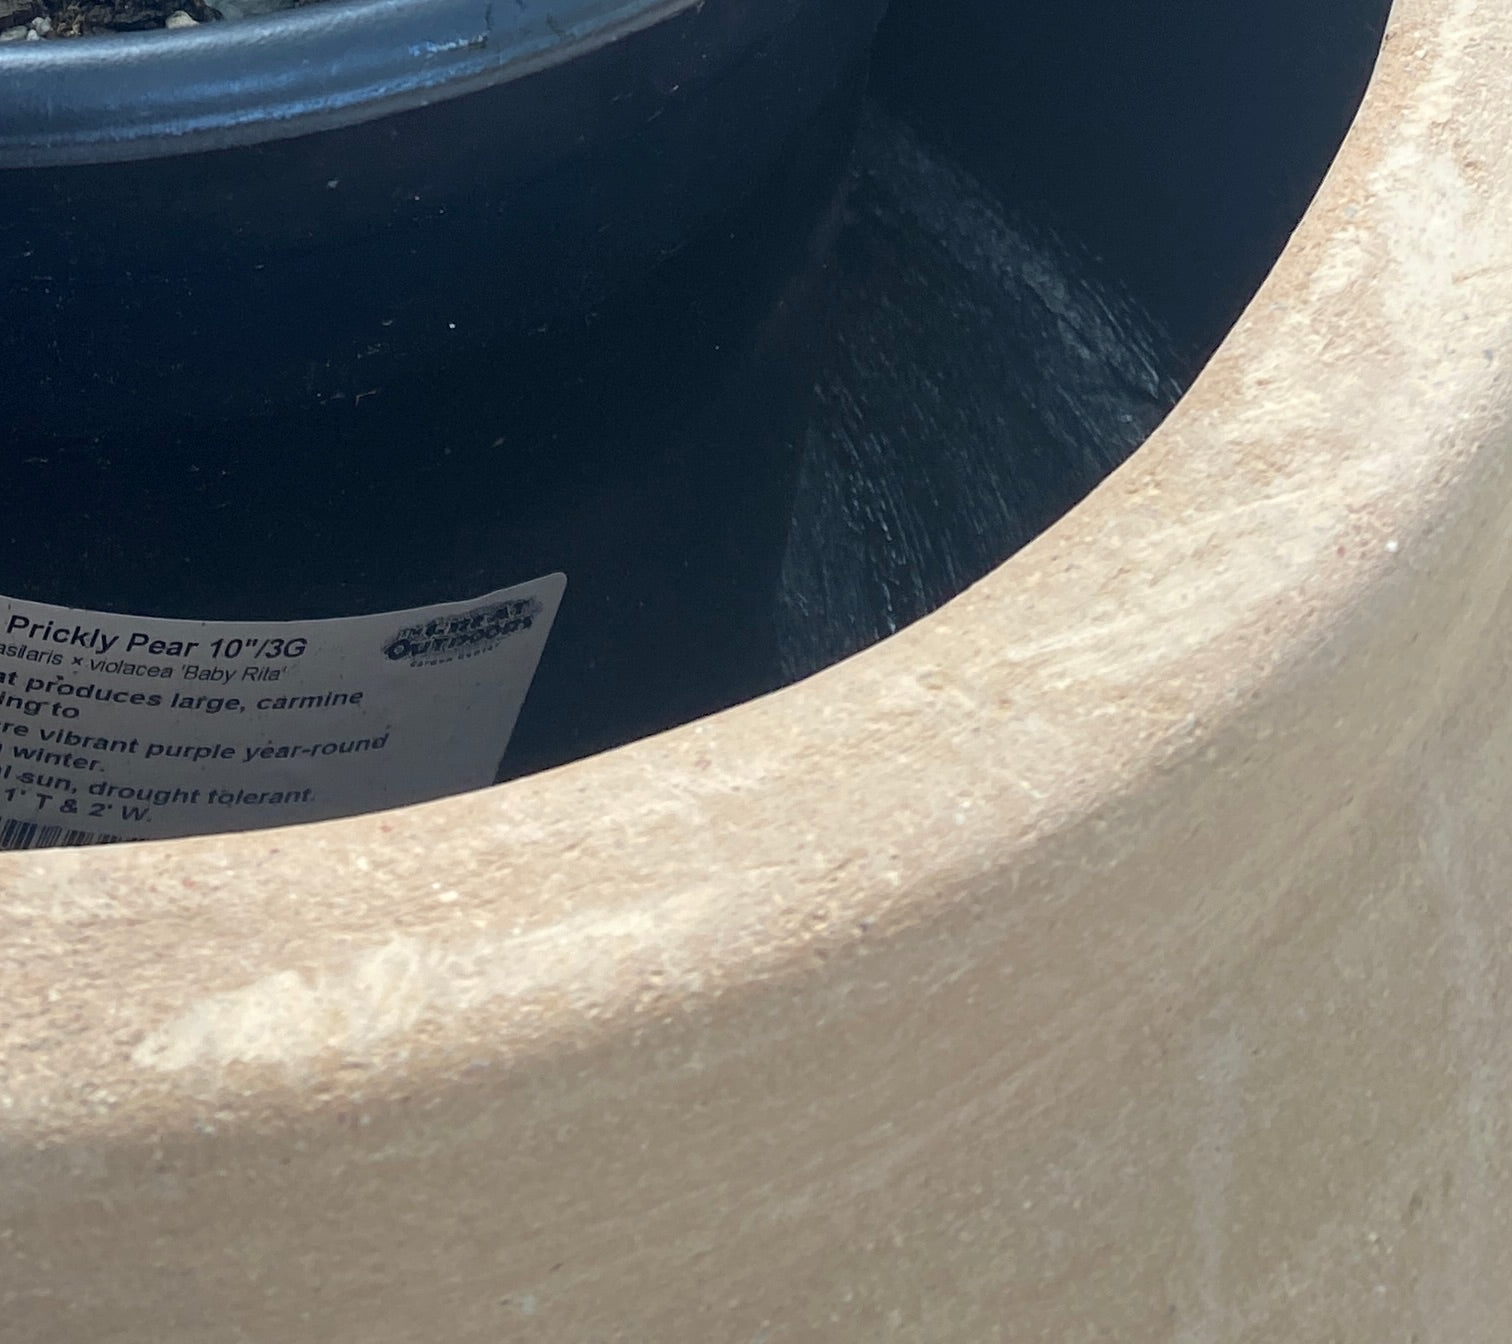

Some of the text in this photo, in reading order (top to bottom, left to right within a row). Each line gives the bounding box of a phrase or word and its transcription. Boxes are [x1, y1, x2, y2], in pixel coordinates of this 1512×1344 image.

[7, 615, 119, 654] Prickly
[126, 633, 200, 657] Pear
[210, 638, 308, 659] 10"/3G
[90, 659, 173, 678] violacea
[25, 677, 161, 707] produces
[171, 693, 246, 714] large,
[256, 691, 364, 710] carmine
[51, 701, 80, 719] to
[13, 745, 105, 772] winter.
[40, 728, 139, 753] vibrant
[145, 743, 236, 762] purple
[241, 733, 389, 763] year-round
[18, 771, 78, 794] sun,
[88, 781, 201, 805] drought
[208, 787, 315, 806] tolerant.
[36, 793, 53, 810] T
[59, 798, 78, 814] &
